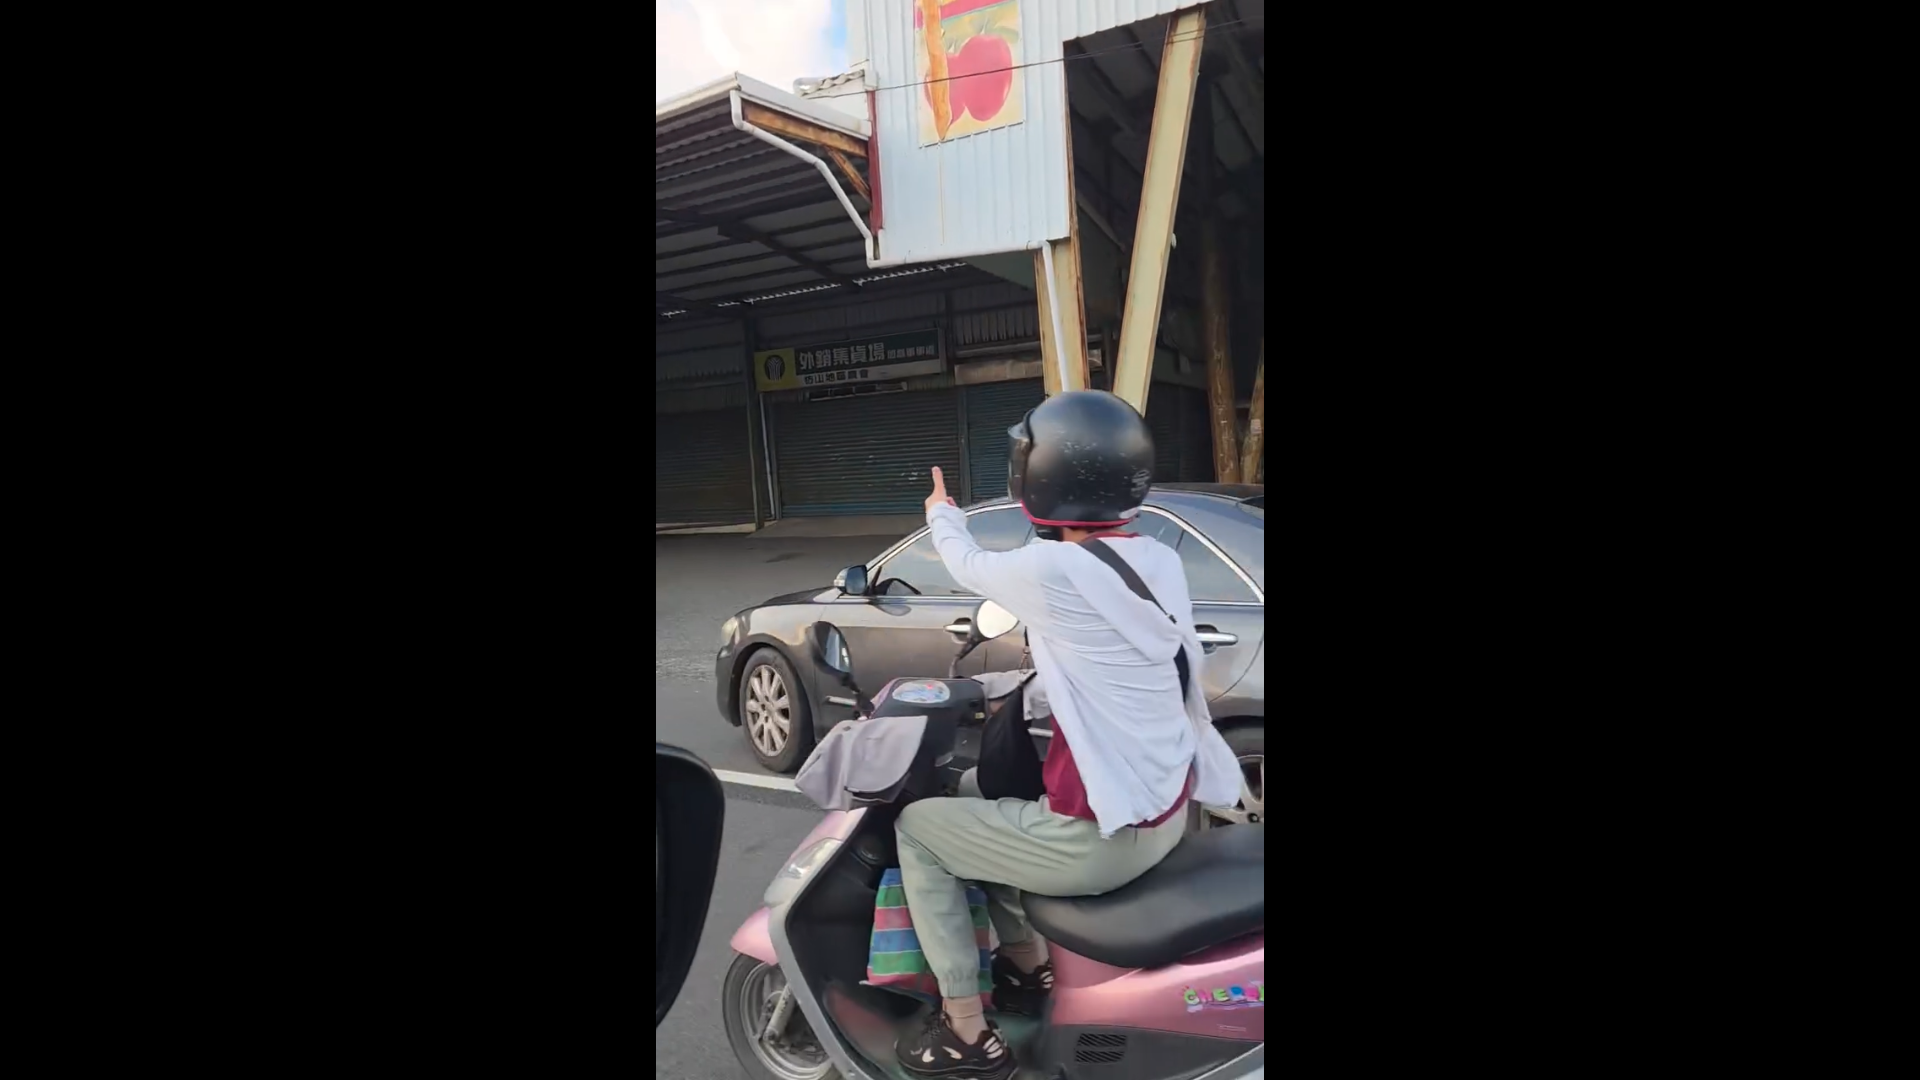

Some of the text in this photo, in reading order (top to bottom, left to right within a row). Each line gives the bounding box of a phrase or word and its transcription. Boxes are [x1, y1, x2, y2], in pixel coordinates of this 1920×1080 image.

[799, 342, 885, 370] 外銷集貨場
